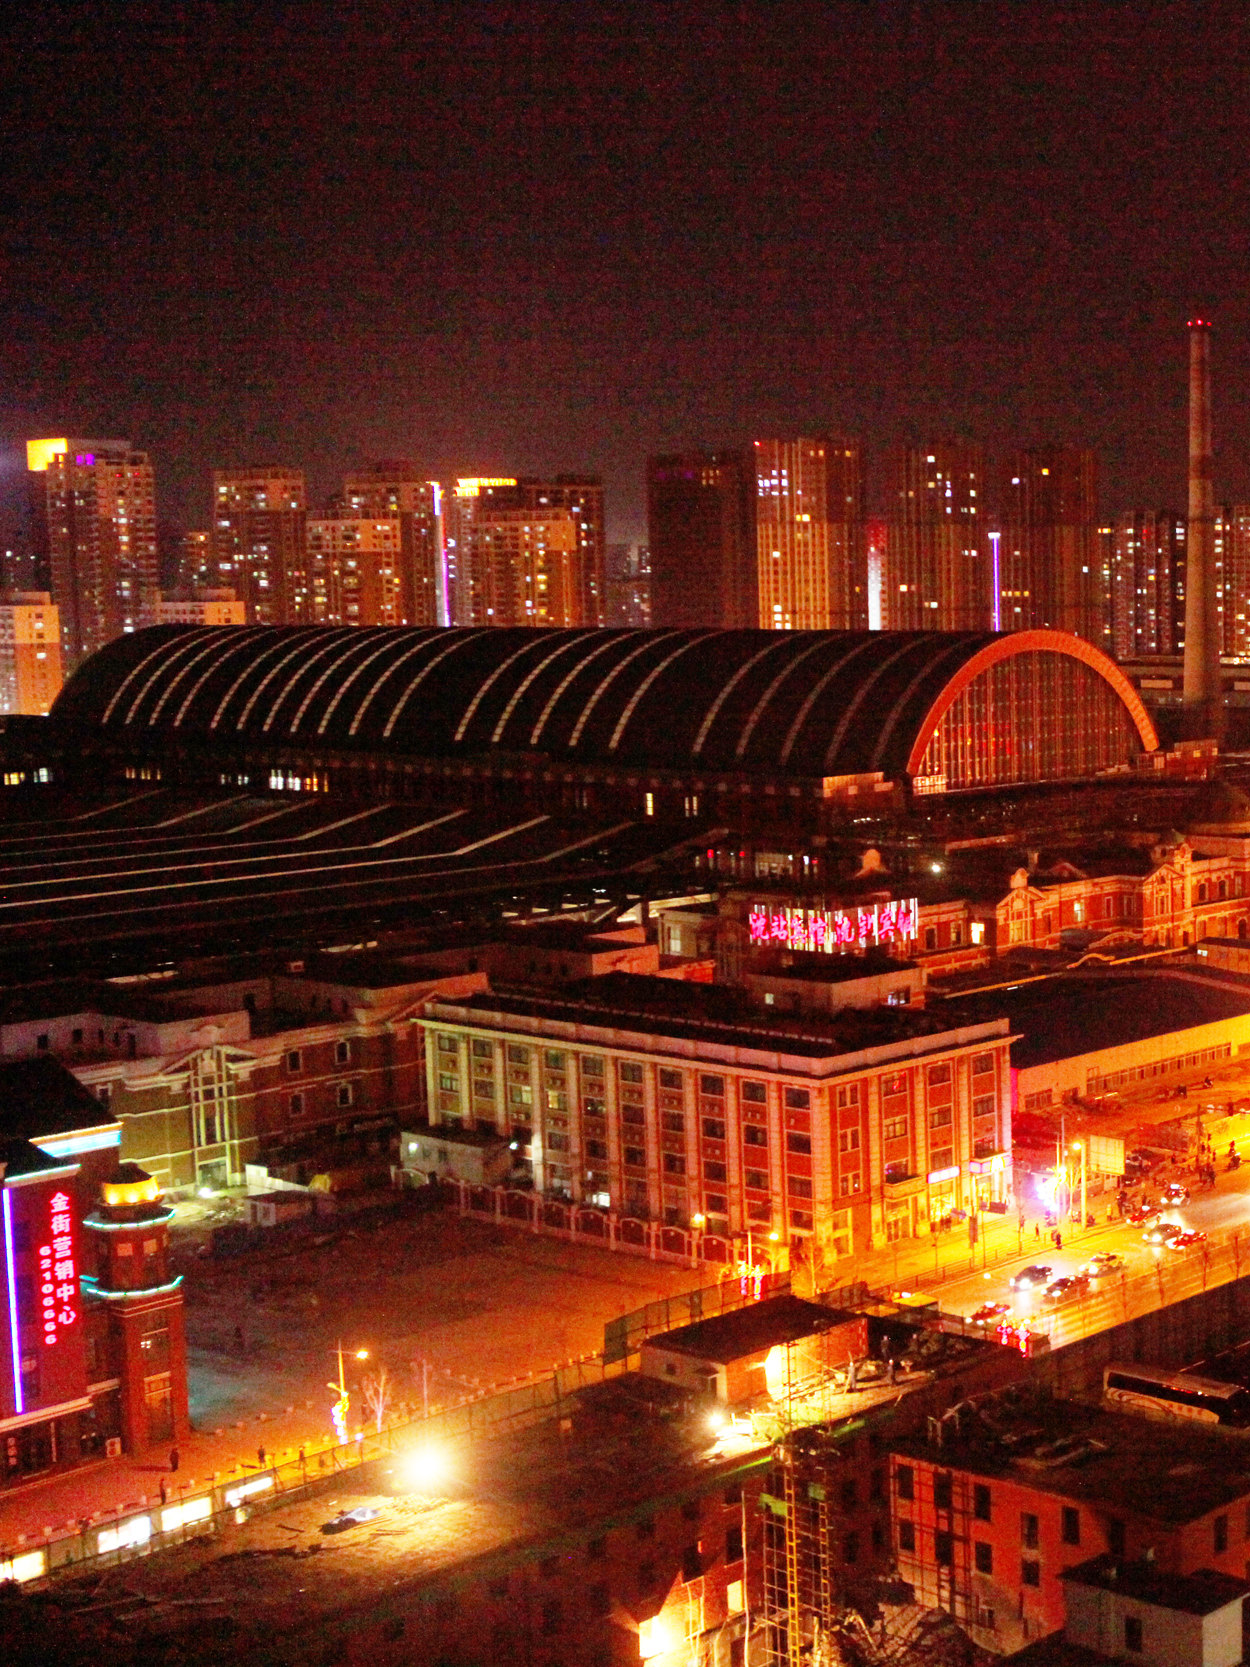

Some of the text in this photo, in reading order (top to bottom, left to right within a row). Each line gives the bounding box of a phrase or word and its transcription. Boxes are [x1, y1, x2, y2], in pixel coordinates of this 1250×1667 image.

[38, 1245, 58, 1345] 62106666
[49, 1191, 77, 1325] 金街营销中心
